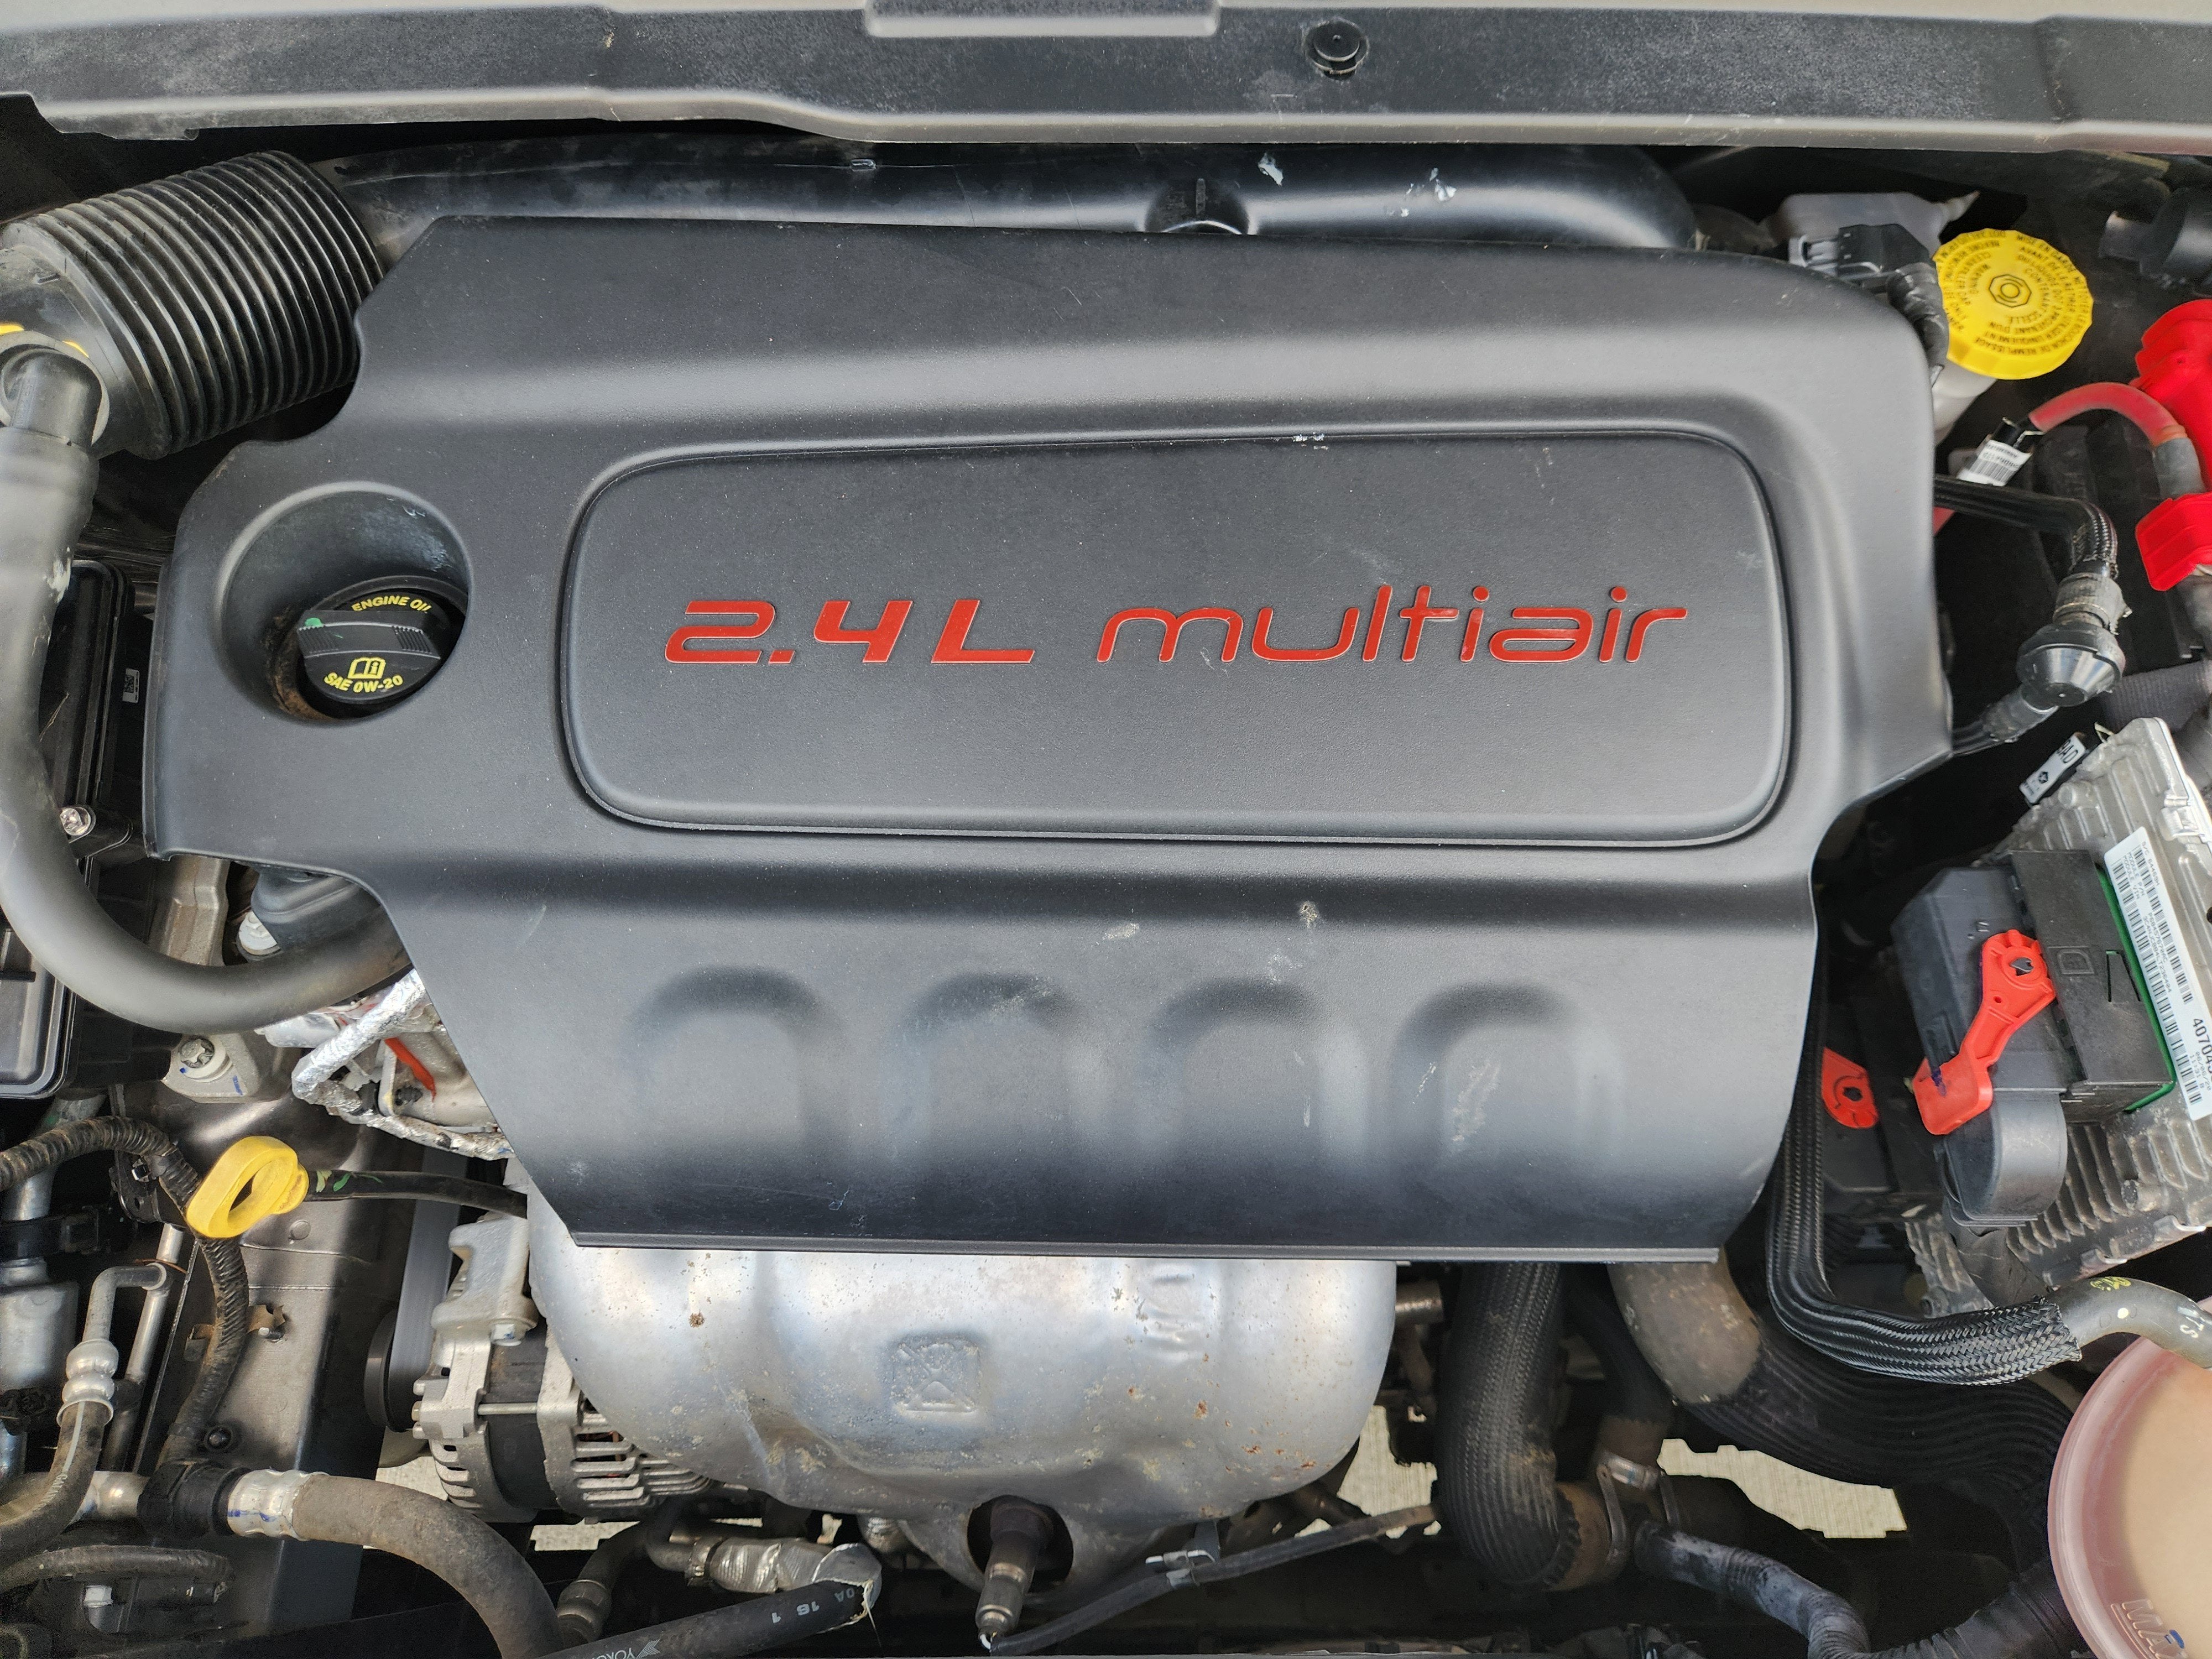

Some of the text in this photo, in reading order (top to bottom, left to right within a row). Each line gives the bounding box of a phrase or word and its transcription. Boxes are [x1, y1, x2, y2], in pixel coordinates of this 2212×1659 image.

[351, 596, 432, 613] ENGINE OIL
[1097, 585, 1687, 662] multiair
[324, 672, 403, 693] SAE 0W-20
[2124, 855, 2133, 881] MODULE
[2128, 852, 2140, 878] MODULE
[2190, 1055, 2201, 1077] 11:31
[797, 1601, 819, 1615] 16
